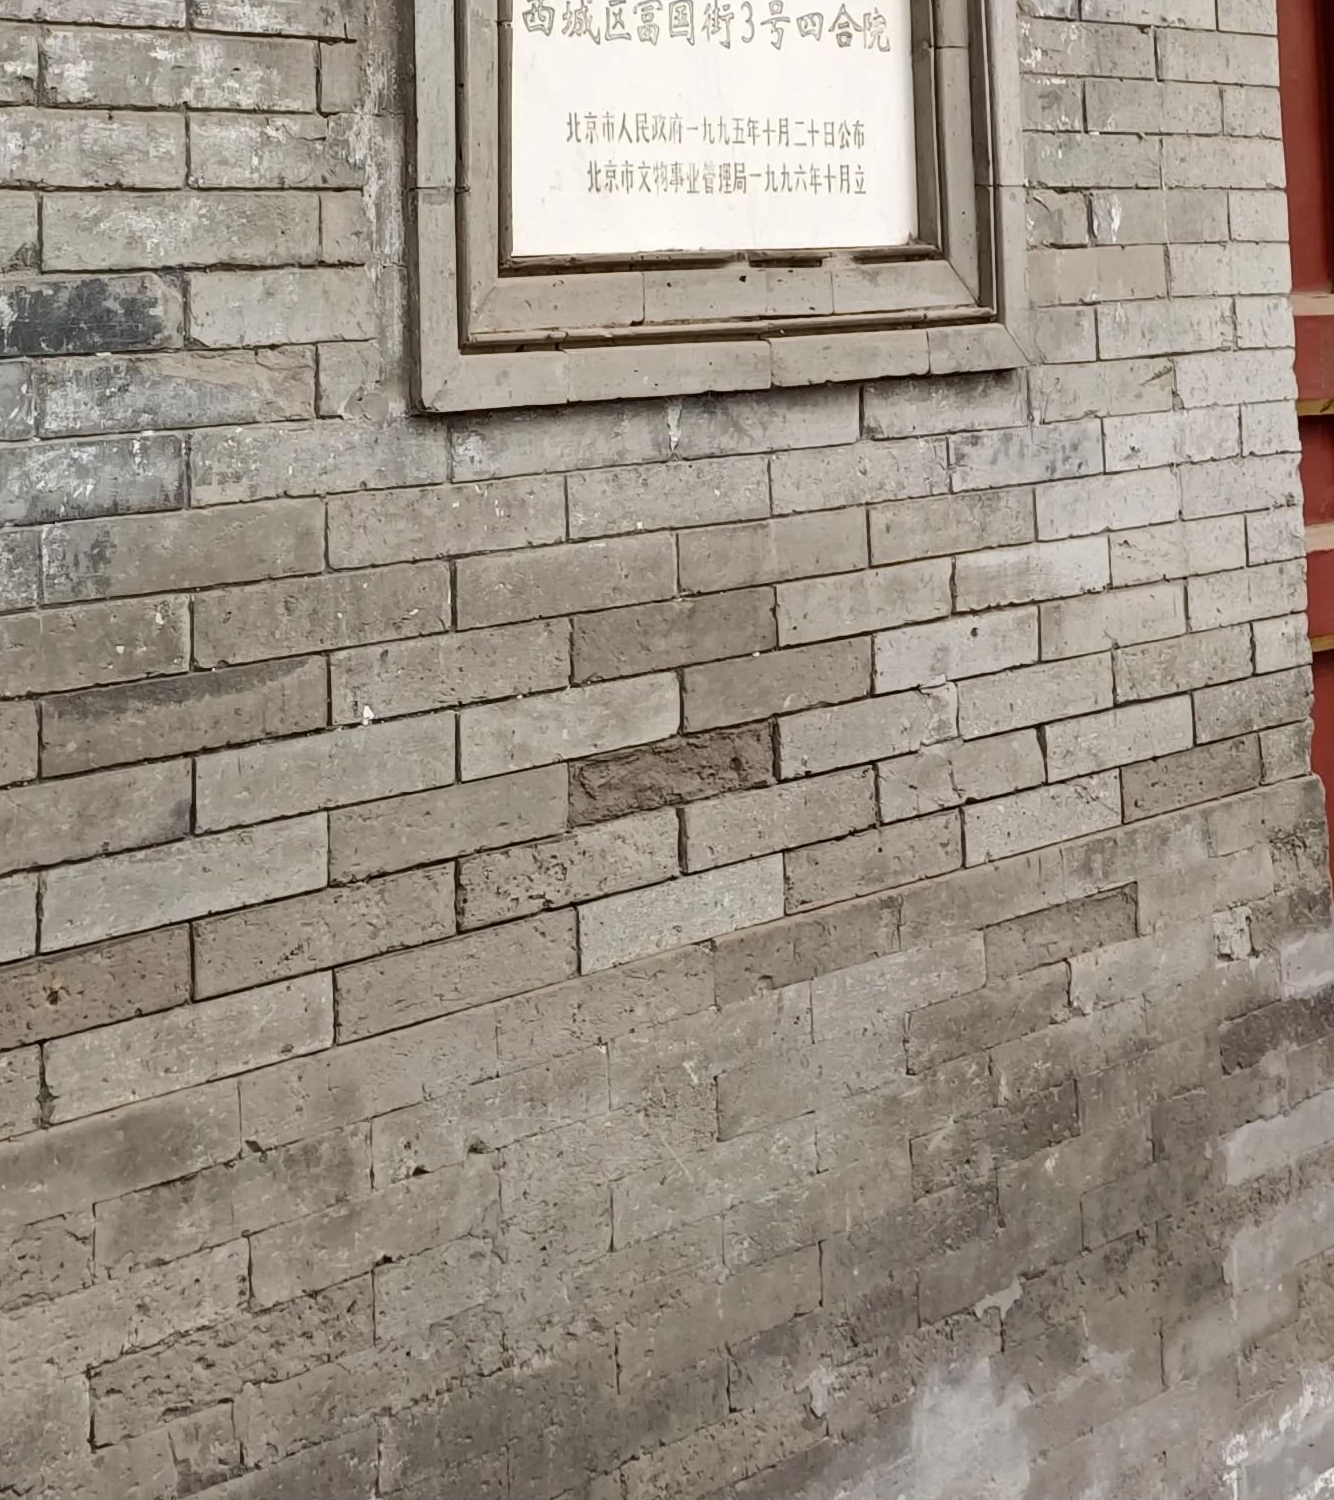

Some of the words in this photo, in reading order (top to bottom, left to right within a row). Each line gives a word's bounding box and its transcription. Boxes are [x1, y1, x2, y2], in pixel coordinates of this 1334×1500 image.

[565, 111, 867, 150] 北京市人民政府一九九五年十月二十日公布
